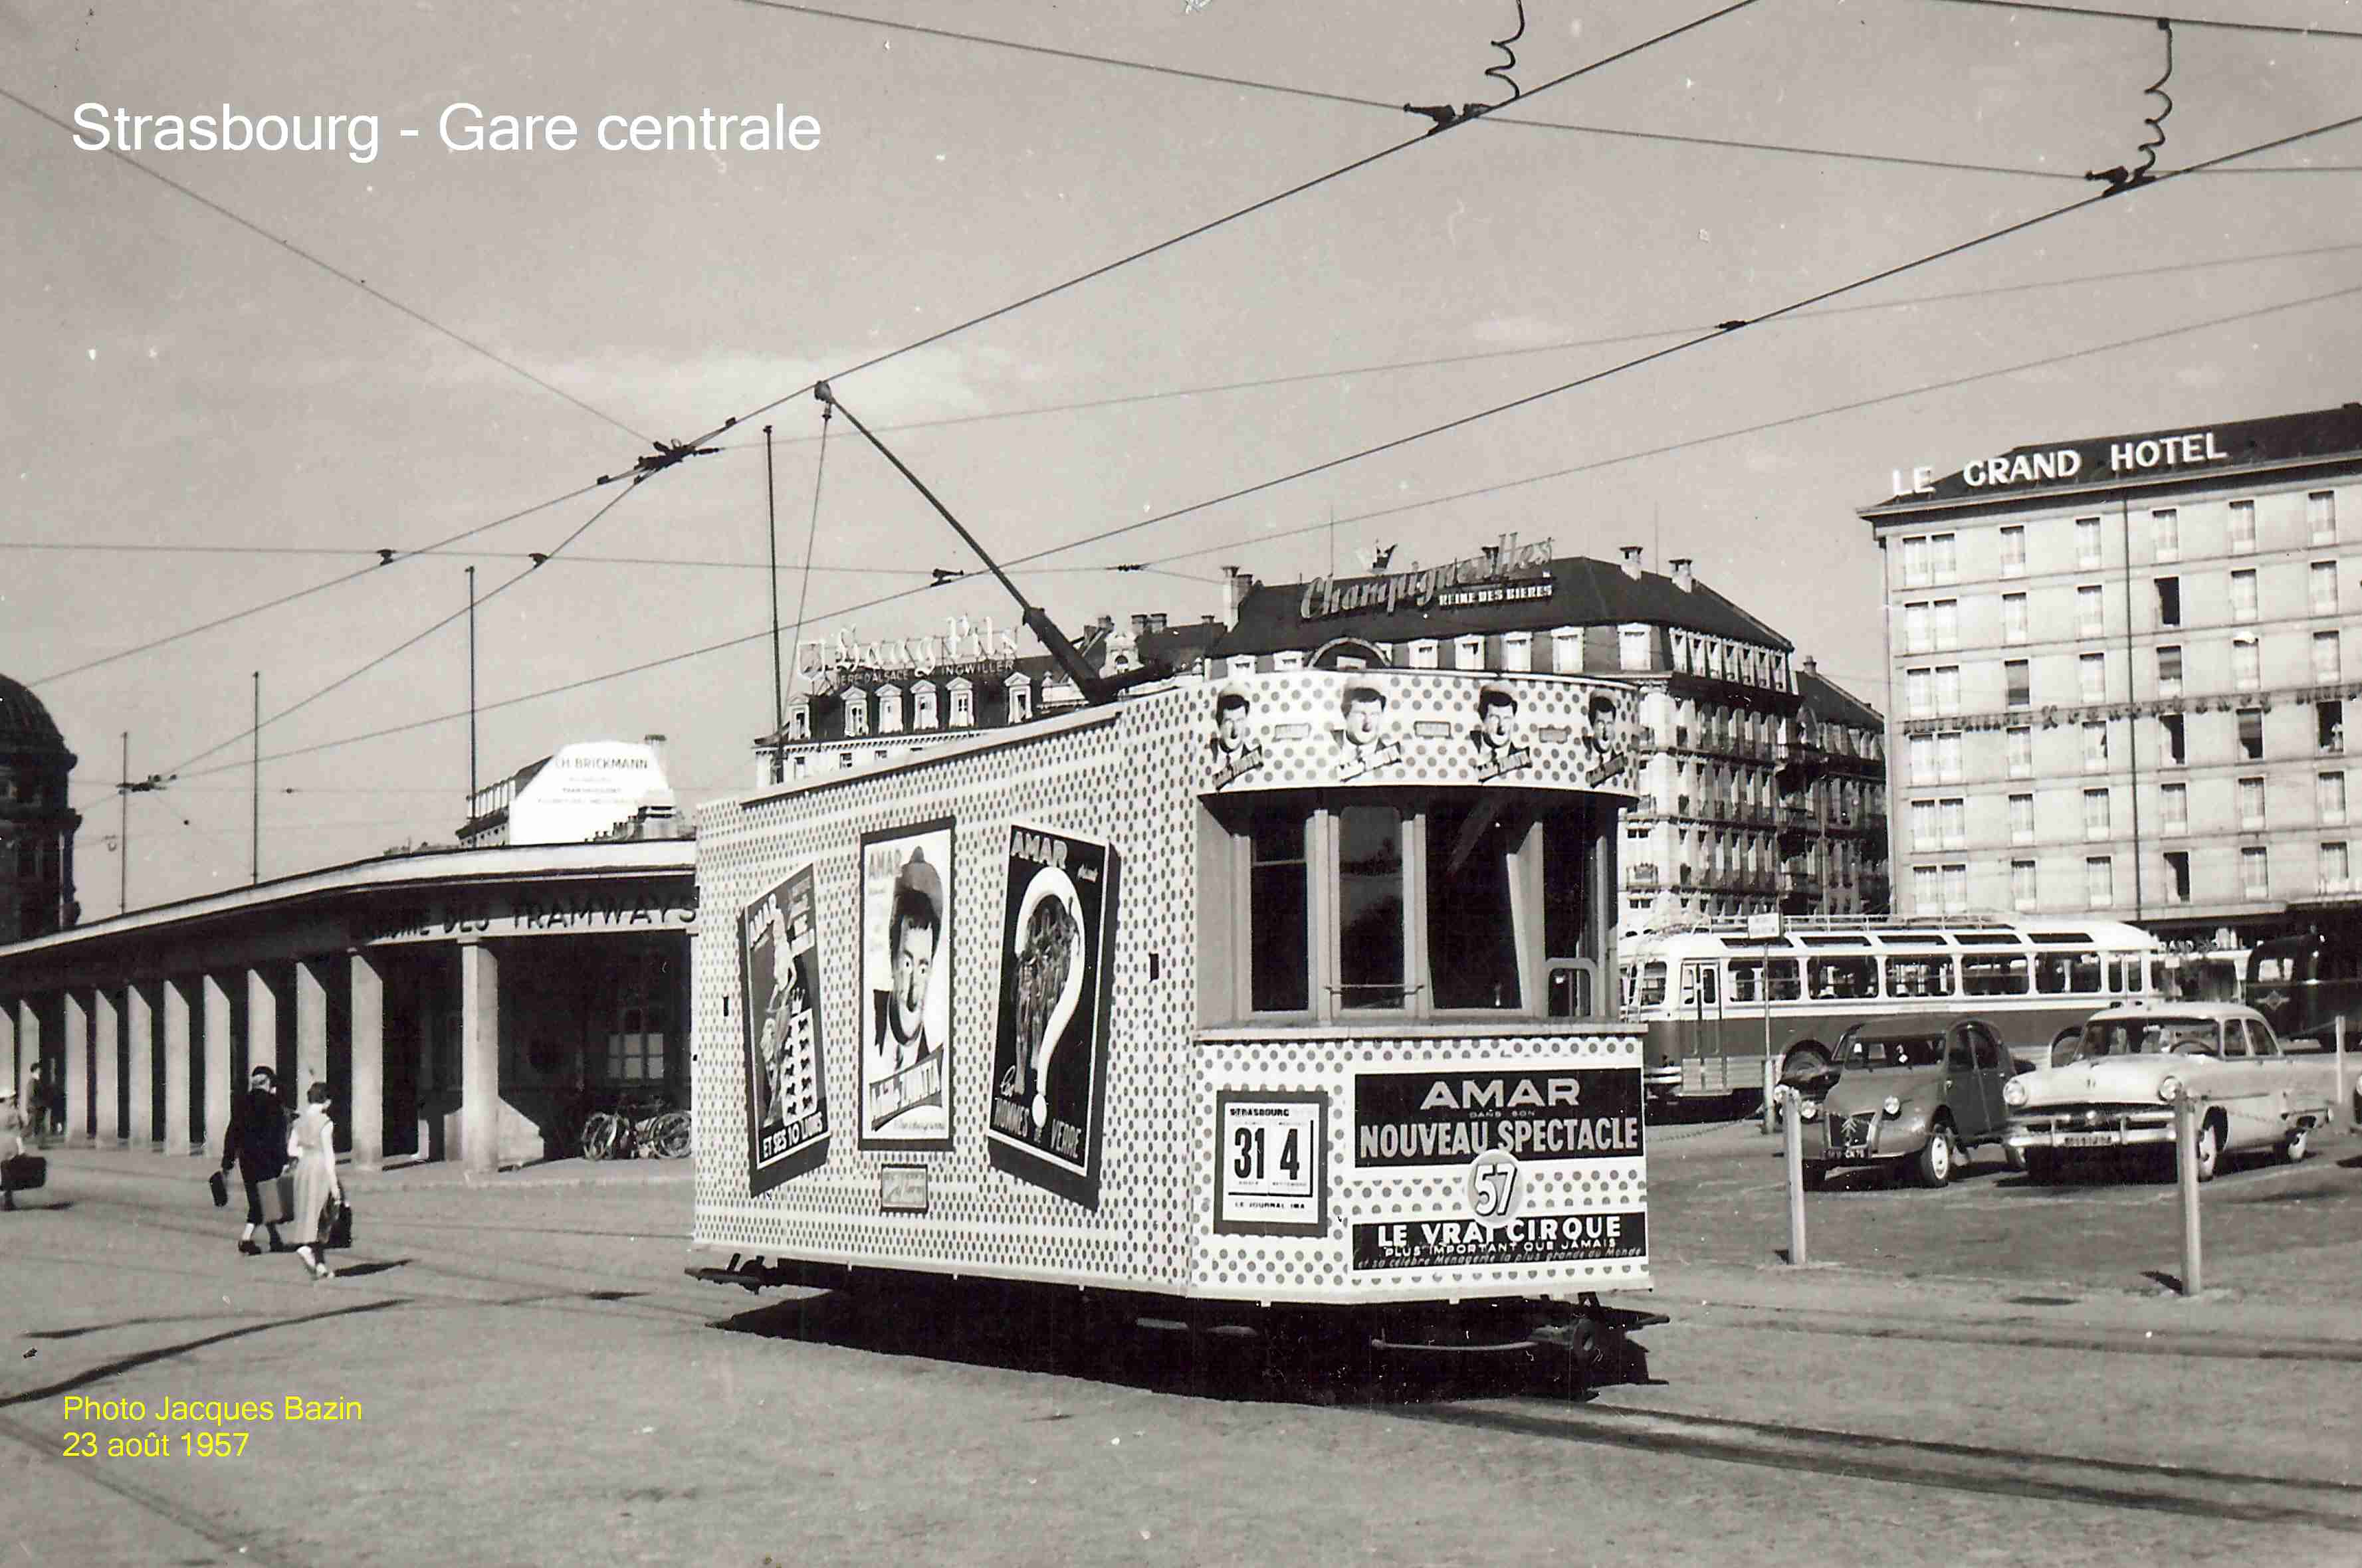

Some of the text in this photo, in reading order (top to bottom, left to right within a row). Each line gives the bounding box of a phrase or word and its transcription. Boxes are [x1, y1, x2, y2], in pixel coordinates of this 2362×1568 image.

[1891, 432, 2228, 496] LE GRAND HOTEL
[1439, 585, 1553, 606] REINE DES BIERES
[942, 660, 1015, 676] INGWILLER
[574, 757, 648, 770] BRICKMANN
[868, 849, 903, 879] AMAR
[1010, 831, 1067, 869] AMAR
[511, 894, 697, 930] TRAMWAYS
[1420, 1078, 1580, 1110] AMAR
[1230, 1108, 1289, 1117] STRASBOURG
[763, 1135, 772, 1159] ET
[773, 1129, 787, 1153] SES
[788, 1124, 800, 1147] 10
[1051, 1118, 1082, 1158] VERRE
[1234, 1127, 1300, 1180] 31 4
[1360, 1118, 1638, 1159] NOUVEAU SPECTACLE
[1473, 1163, 1518, 1217] 57
[1378, 1216, 1621, 1247] LE VRAI CIRQUE
[1385, 1238, 1616, 1256] PLUS IMPORTANT QUE JAMAIS
[1371, 1259, 1385, 1268] sa
[1500, 1252, 1511, 1262] la
[1514, 1251, 1540, 1264] plus
[1547, 1249, 1584, 1262] grande
[1588, 1248, 1600, 1258] du
[1605, 1246, 1642, 1257] Monde
